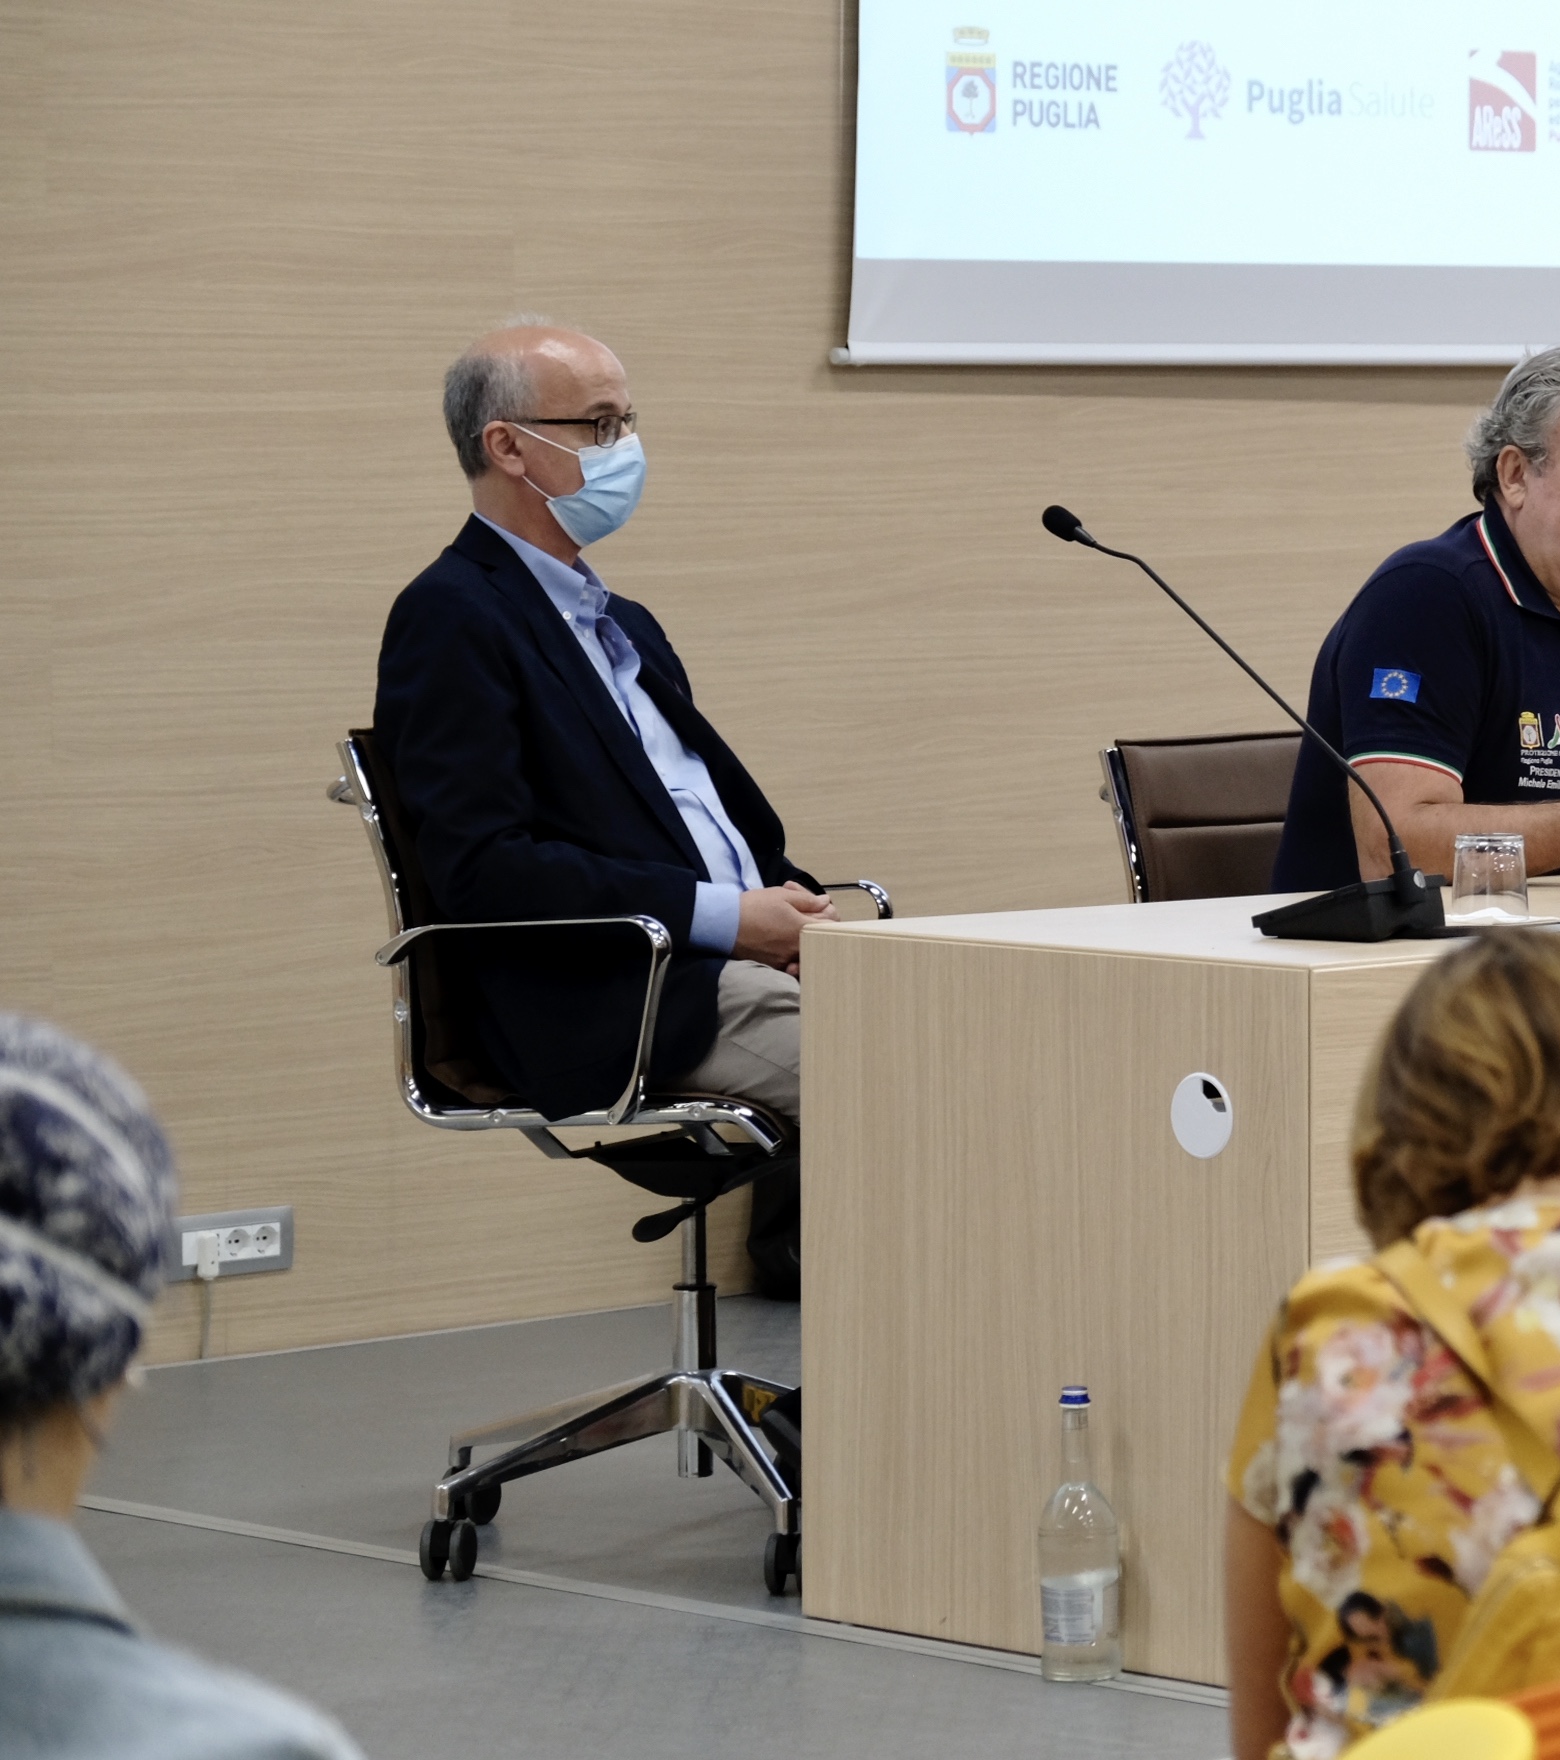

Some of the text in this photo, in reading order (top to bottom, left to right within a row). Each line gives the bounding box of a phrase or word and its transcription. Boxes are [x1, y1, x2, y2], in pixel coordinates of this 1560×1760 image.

[1012, 61, 1118, 92] REGIONE
[1012, 99, 1101, 129] PUGLIA
[1517, 776, 1546, 789] Michele
